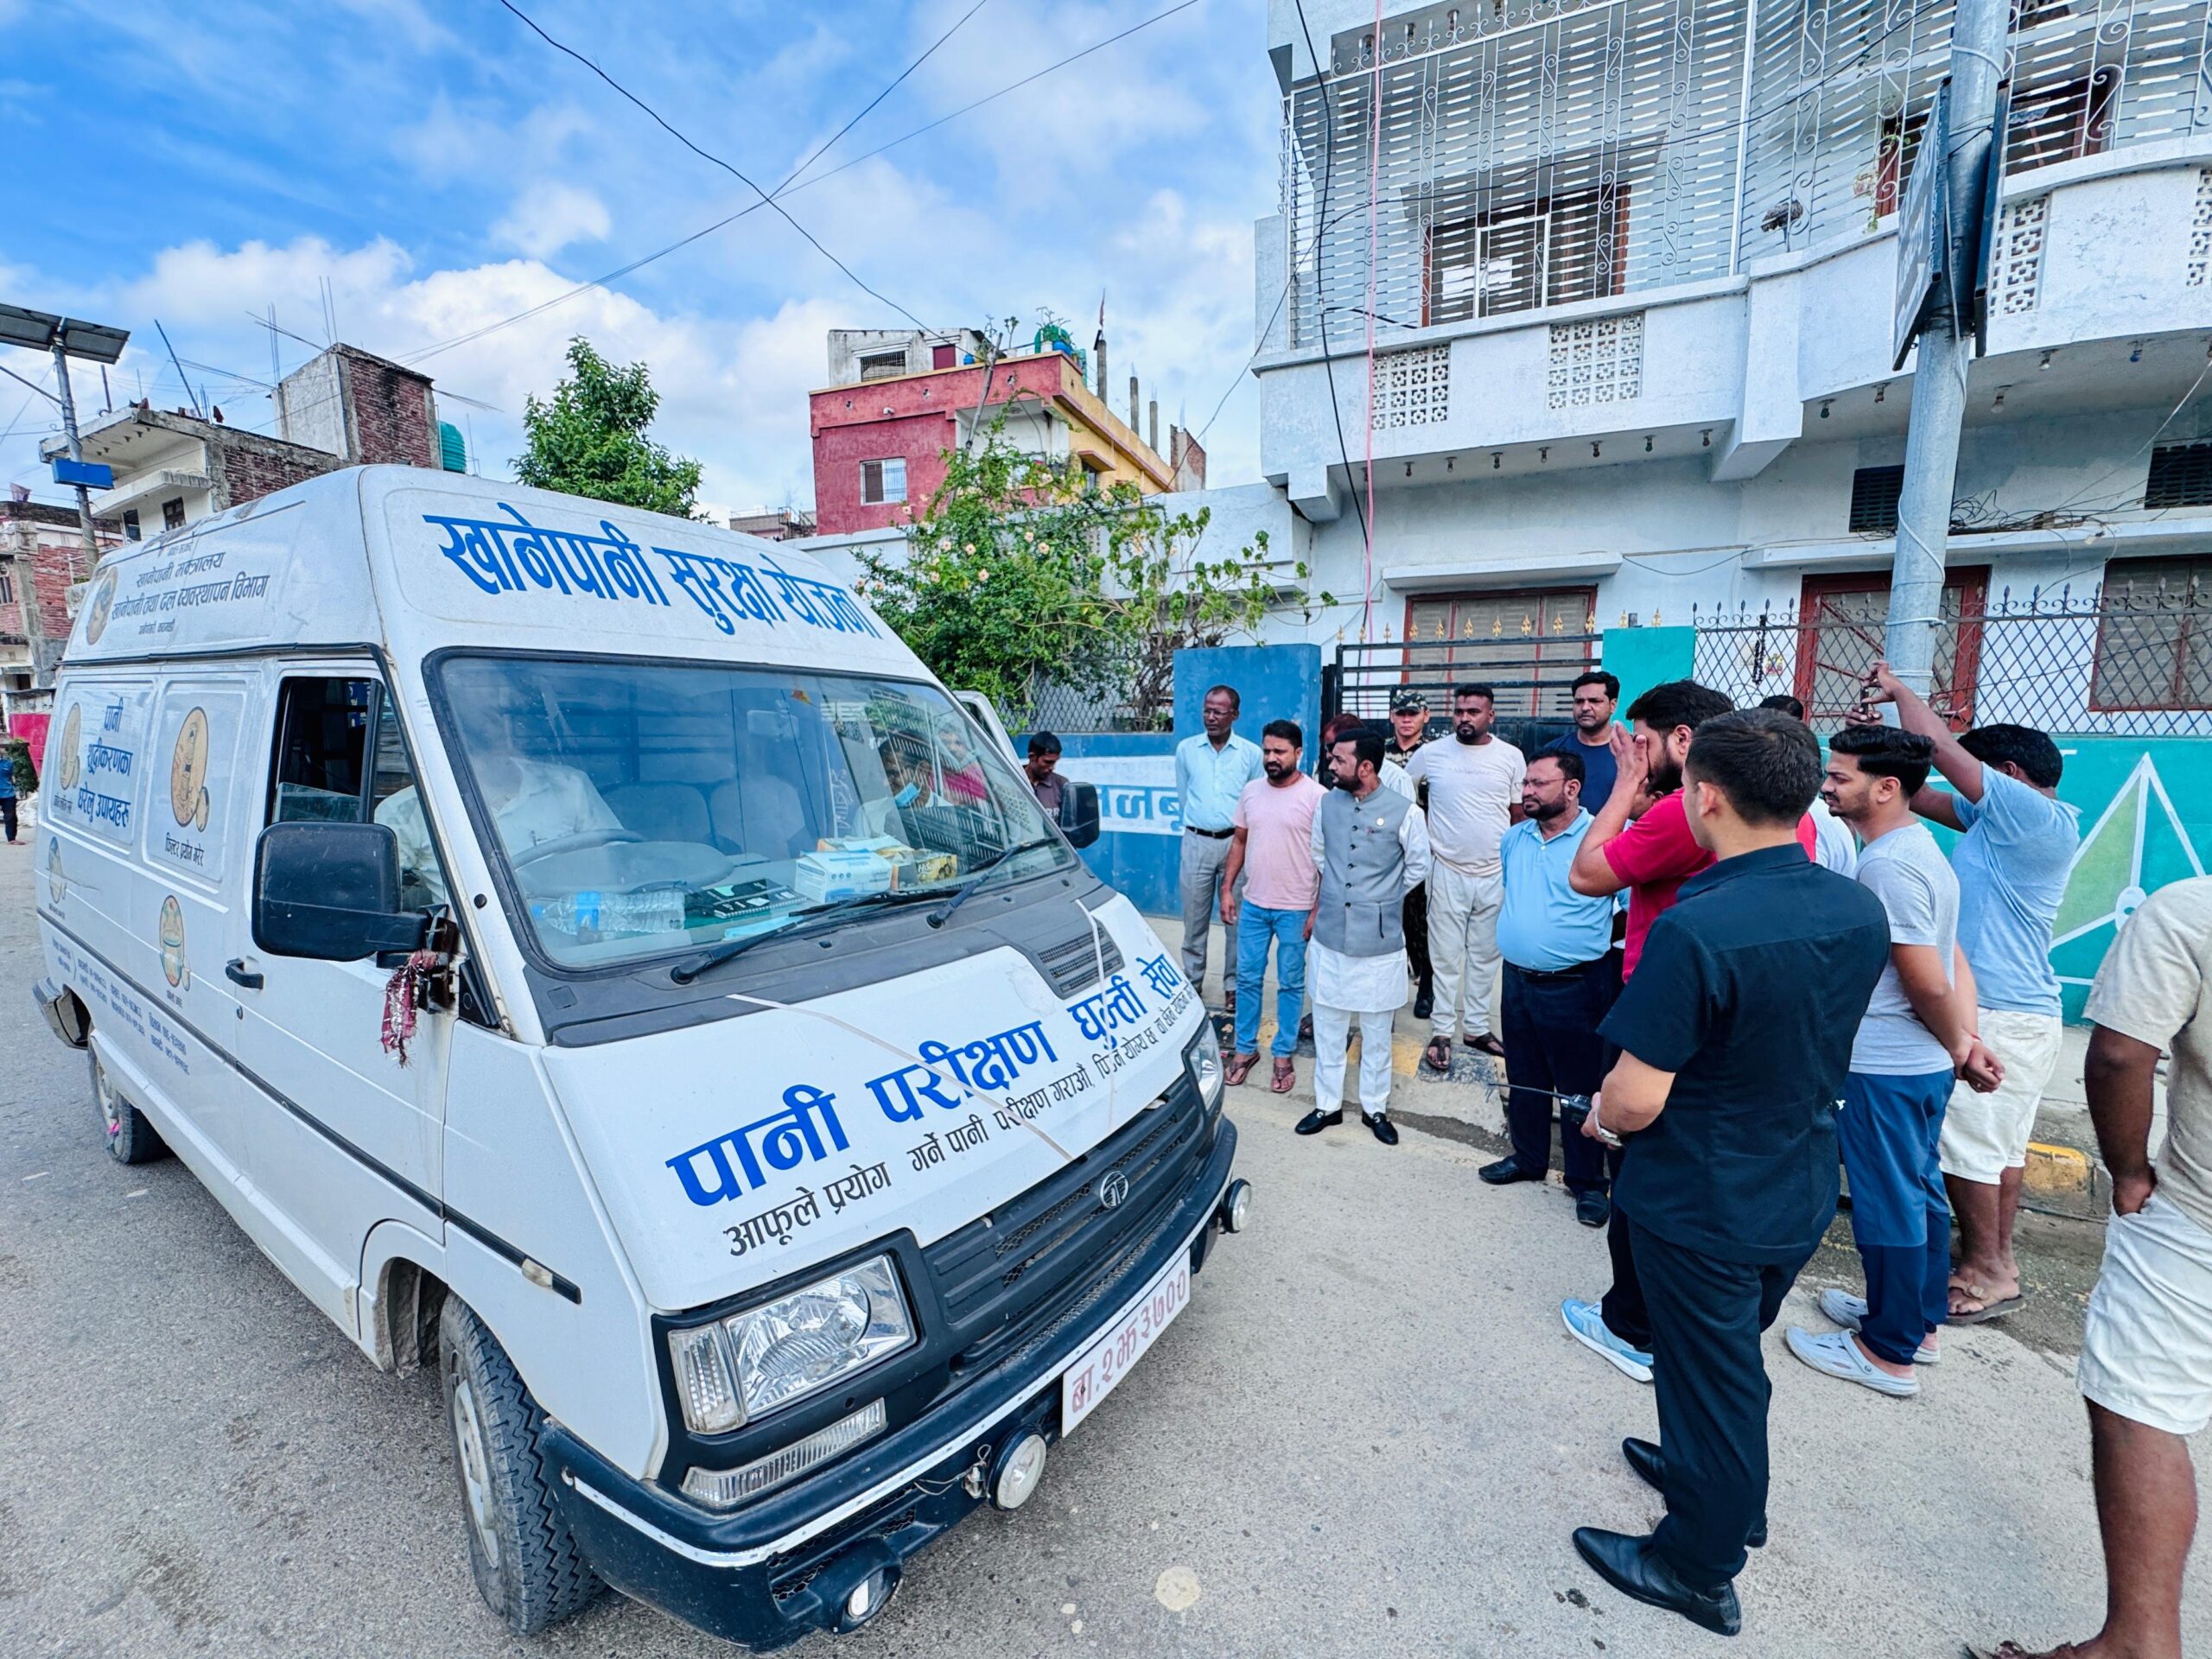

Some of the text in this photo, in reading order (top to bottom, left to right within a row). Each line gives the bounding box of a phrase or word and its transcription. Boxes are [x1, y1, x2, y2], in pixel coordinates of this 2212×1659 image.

[137, 562, 174, 588] खानेपानी
[177, 580, 232, 607] व्यवस्थापन
[230, 571, 270, 601] विभाग
[423, 501, 883, 639] खानेपानी सुरक्षा योजना
[104, 696, 124, 733] पानी
[665, 1084, 850, 1207] पानी
[865, 1019, 1058, 1123] परीक्षण
[1135, 953, 1183, 1001] सेवा
[722, 1185, 821, 1256] आफूले
[822, 1161, 893, 1216] प्रयोग
[906, 1132, 946, 1172] गर्ने
[944, 1114, 990, 1154] पानी
[993, 1088, 1052, 1131] परीक्षण
[1121, 1033, 1149, 1060] योग्य
